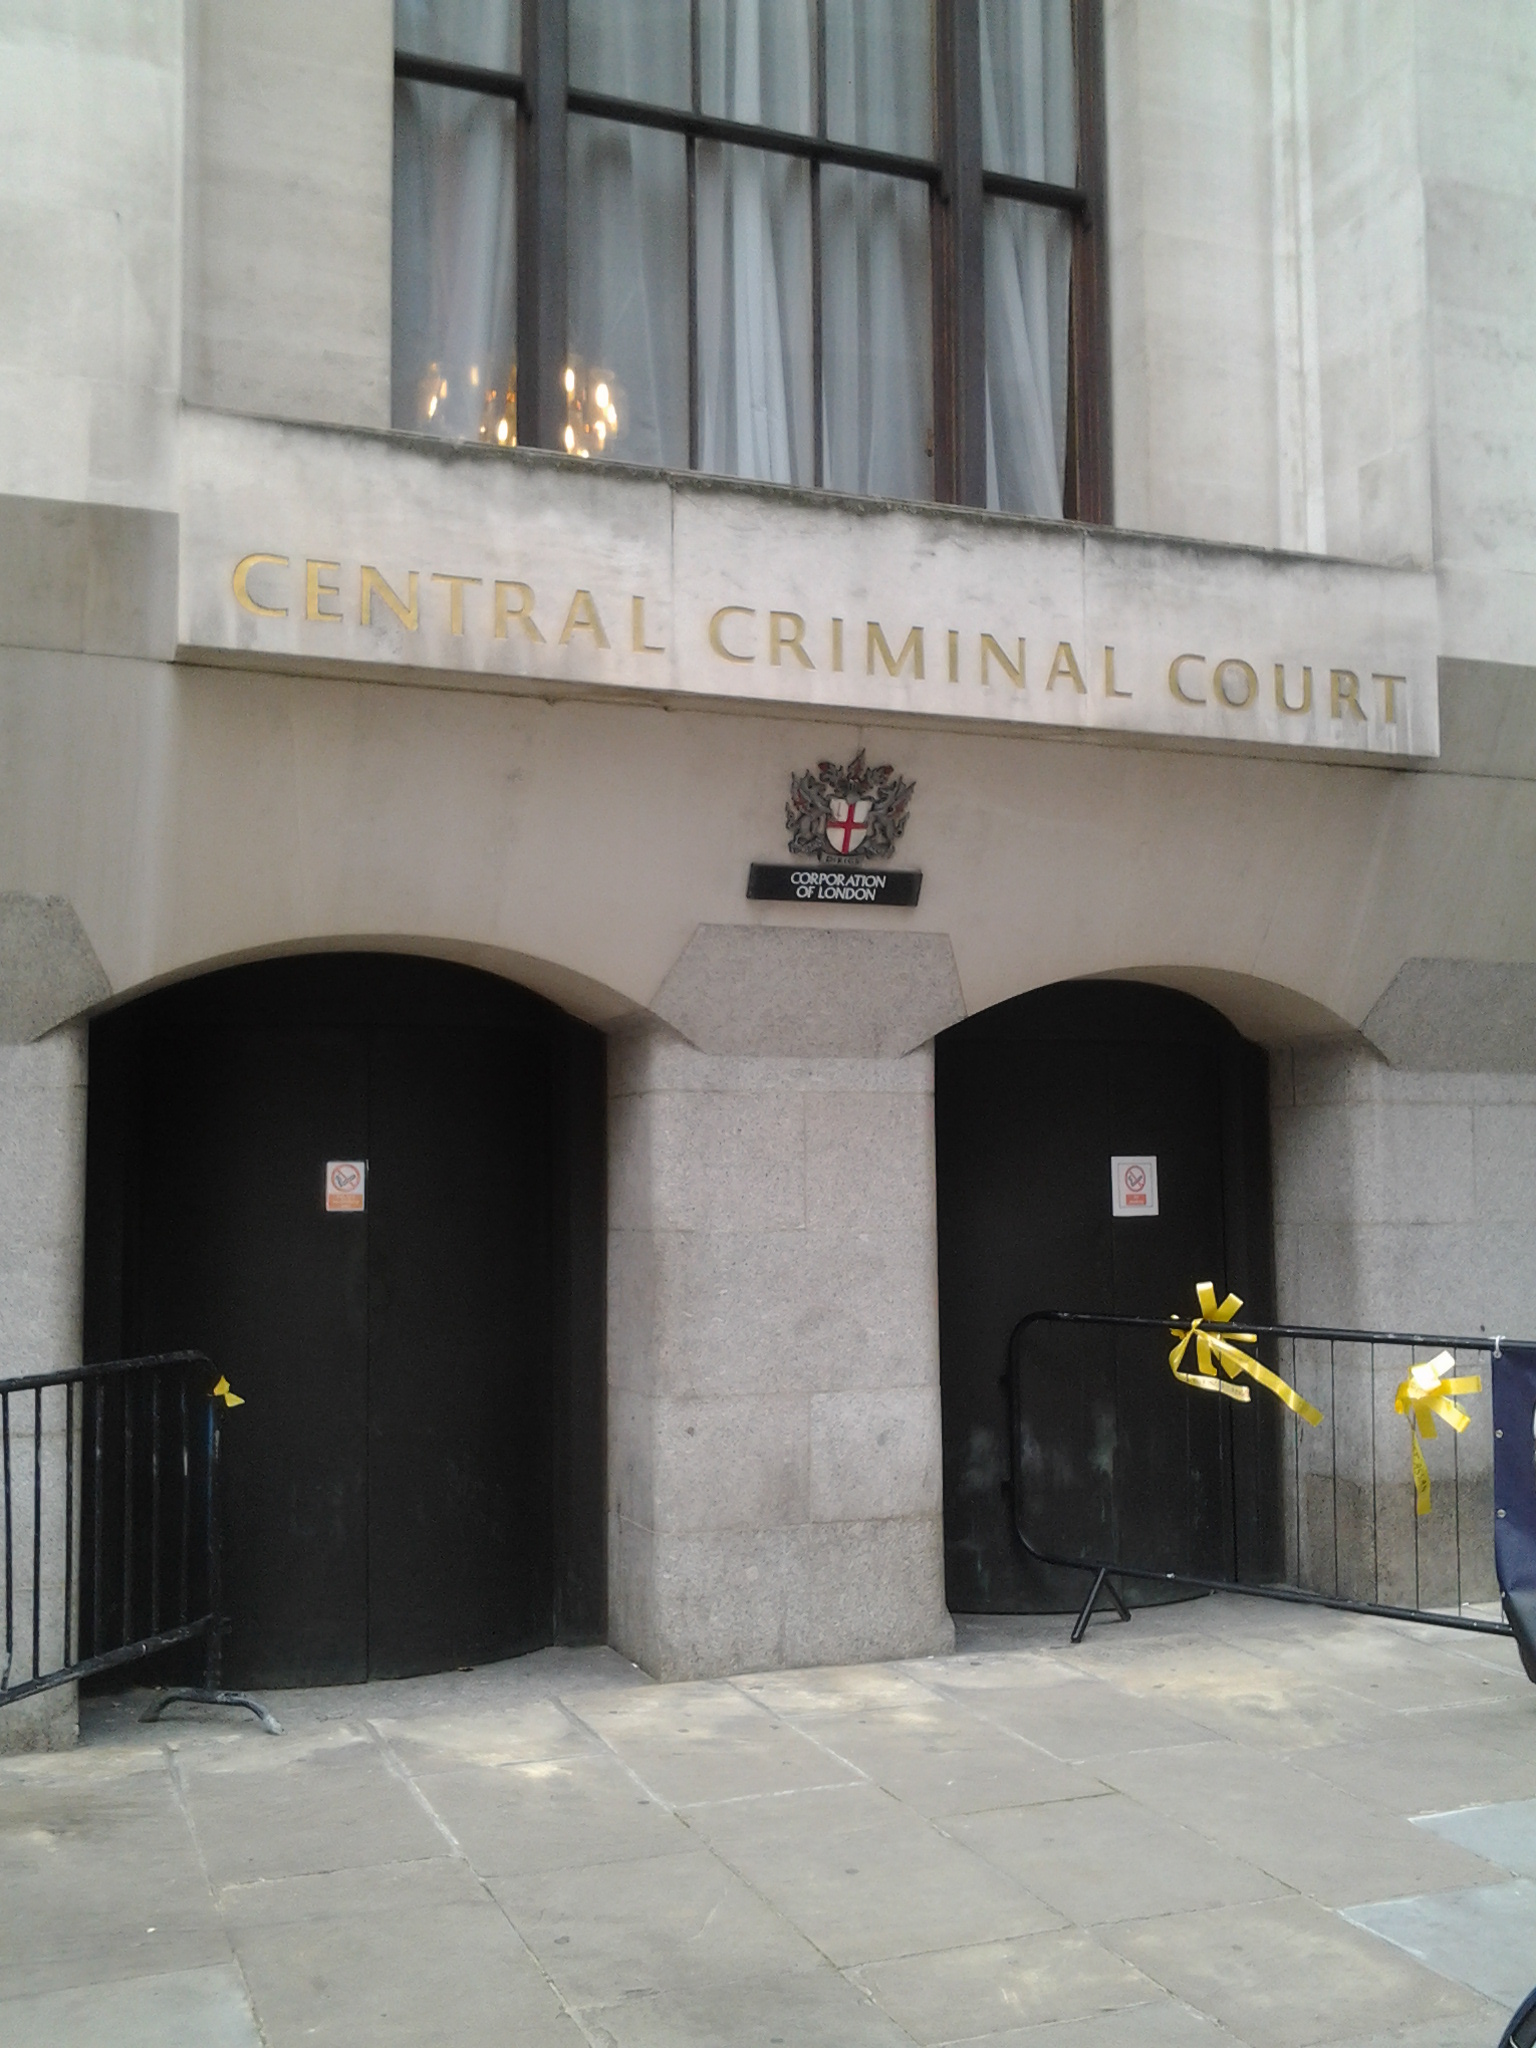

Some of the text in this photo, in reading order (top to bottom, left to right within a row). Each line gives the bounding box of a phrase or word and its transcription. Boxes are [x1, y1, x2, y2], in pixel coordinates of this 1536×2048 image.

[232, 552, 1407, 724] CENTRAL CRIMINAL COURT
[790, 871, 887, 889] CORPORATION
[796, 885, 877, 901] OF LONDON
